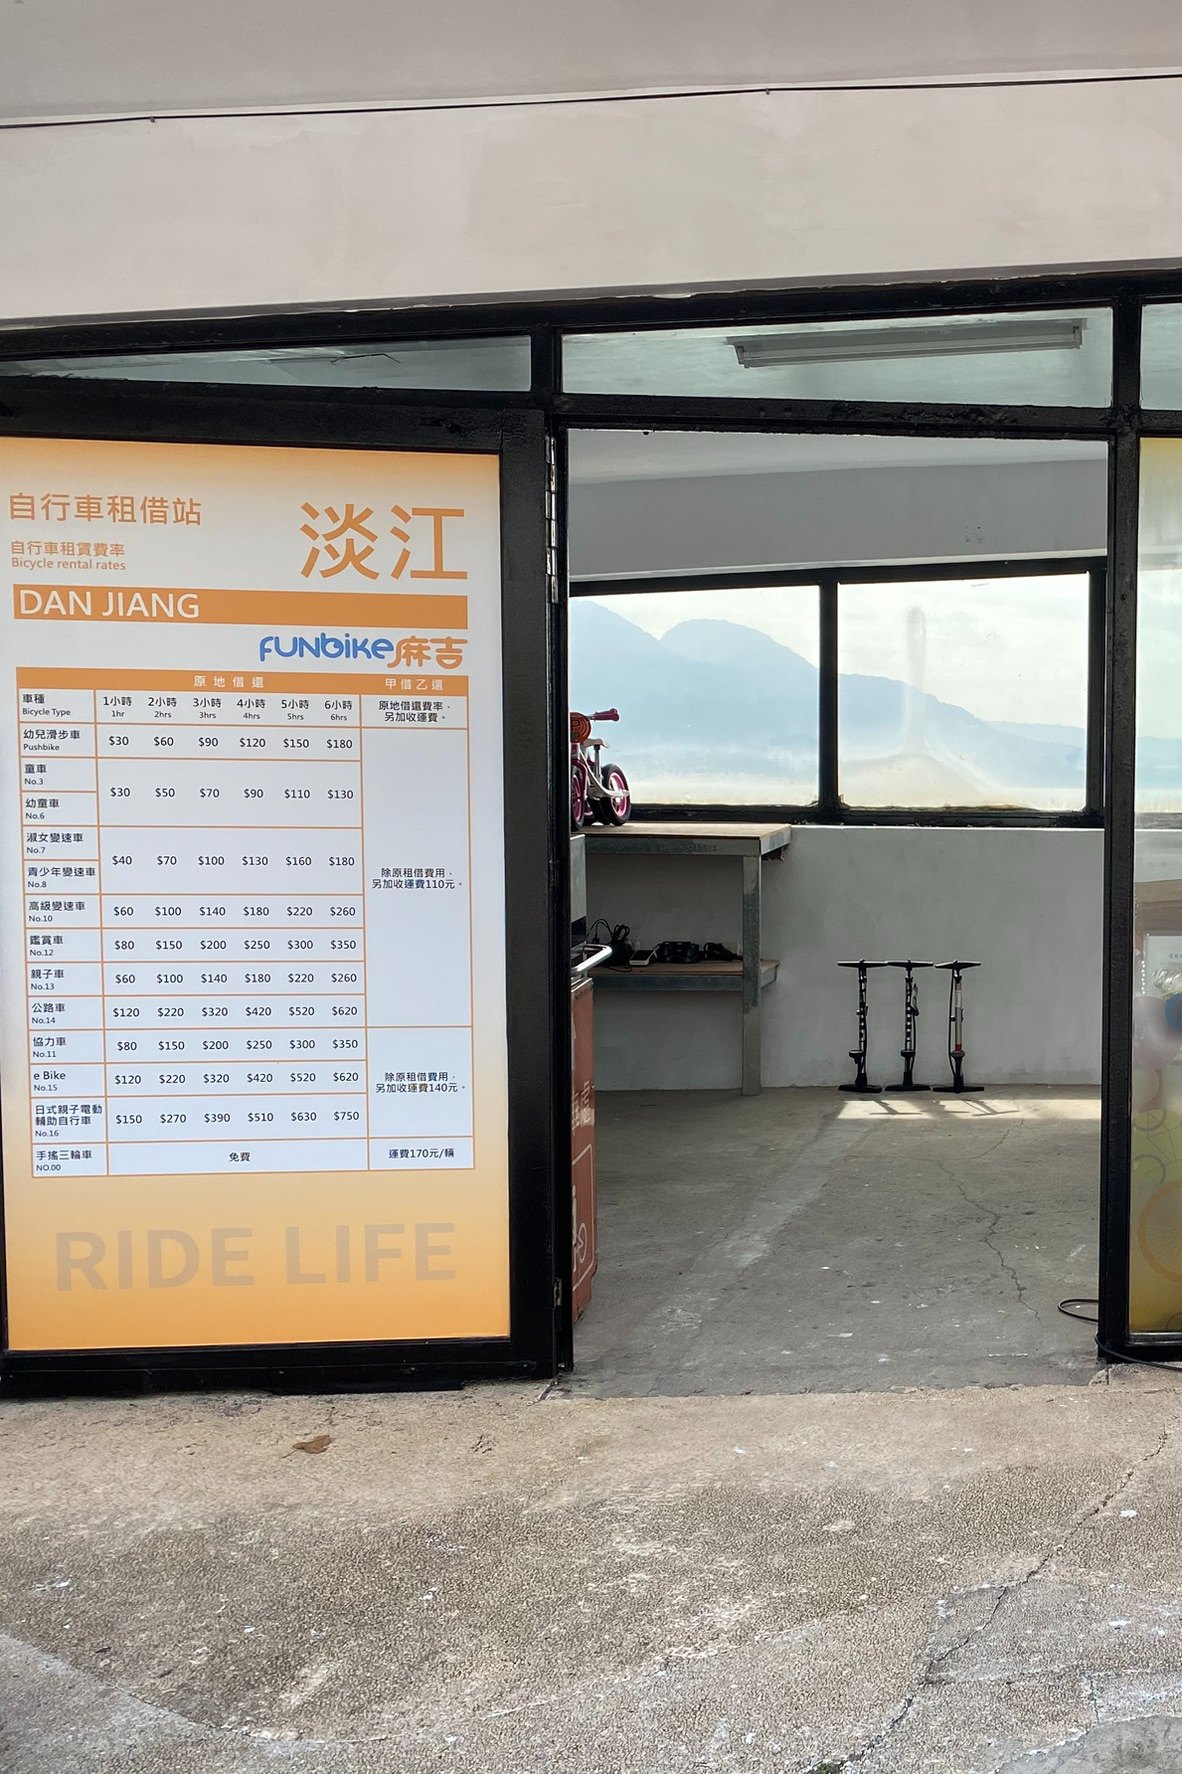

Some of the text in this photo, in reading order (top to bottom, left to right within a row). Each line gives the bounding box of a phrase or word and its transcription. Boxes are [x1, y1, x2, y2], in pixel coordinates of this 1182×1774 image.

[9, 493, 202, 526] 自行車租借站
[299, 502, 468, 580] 淡江
[11, 541, 125, 557] 自行車租賃費率
[11, 557, 126, 570] Bicycle rental rates
[19, 591, 199, 618] DAN JIANG
[194, 676, 262, 688] 原地借還
[385, 679, 443, 690] 甲借乙還
[23, 694, 44, 704] 車種
[104, 696, 352, 710] 1小時 2小時 3小時 4小時 5小時 6小時
[23, 708, 71, 717] Bicycle Type
[24, 729, 80, 739] 幼兒滑步車
[109, 736, 352, 748] $30 $60 $90 $120 $150 $180
[25, 764, 47, 774] 童車
[110, 787, 353, 799] $30 $50 $70 $90 $110 $130
[26, 798, 59, 808] 幼童車
[27, 833, 83, 843] 淑女變速車
[112, 856, 354, 866] $40 $70 $100 $130 $160 $180
[28, 867, 95, 877] 青少年變速車
[29, 901, 85, 911] 高級變速車
[114, 907, 355, 916] $60 $100 $140 $180 $220 $260
[30, 935, 63, 945] 鑑賞車
[115, 940, 356, 950] $80 $150 $200 $250 $300 $350
[31, 969, 64, 979] 親子車
[116, 973, 357, 984] $60 $100 $140 $180 $220 $260
[32, 1003, 65, 1013] 公路車
[113, 1006, 357, 1017] $120 $220 $320 $420 $520 $620
[33, 1037, 66, 1047] 協力車
[117, 1039, 358, 1051] $80 $150 $200 $250 $300 $350
[43, 1071, 66, 1080] Bike
[115, 1072, 358, 1084] $120 $220 $320 $420 $520 $620
[36, 1104, 102, 1114] 日式親子電動
[36, 1116, 91, 1126] 輔助自行車
[116, 1112, 359, 1124] $150 $270 $390 $510 $630 $750
[36, 1150, 92, 1160] 手搖三輪車
[229, 1152, 250, 1162] 免費
[56, 1222, 457, 1291] RIDE LIFE
